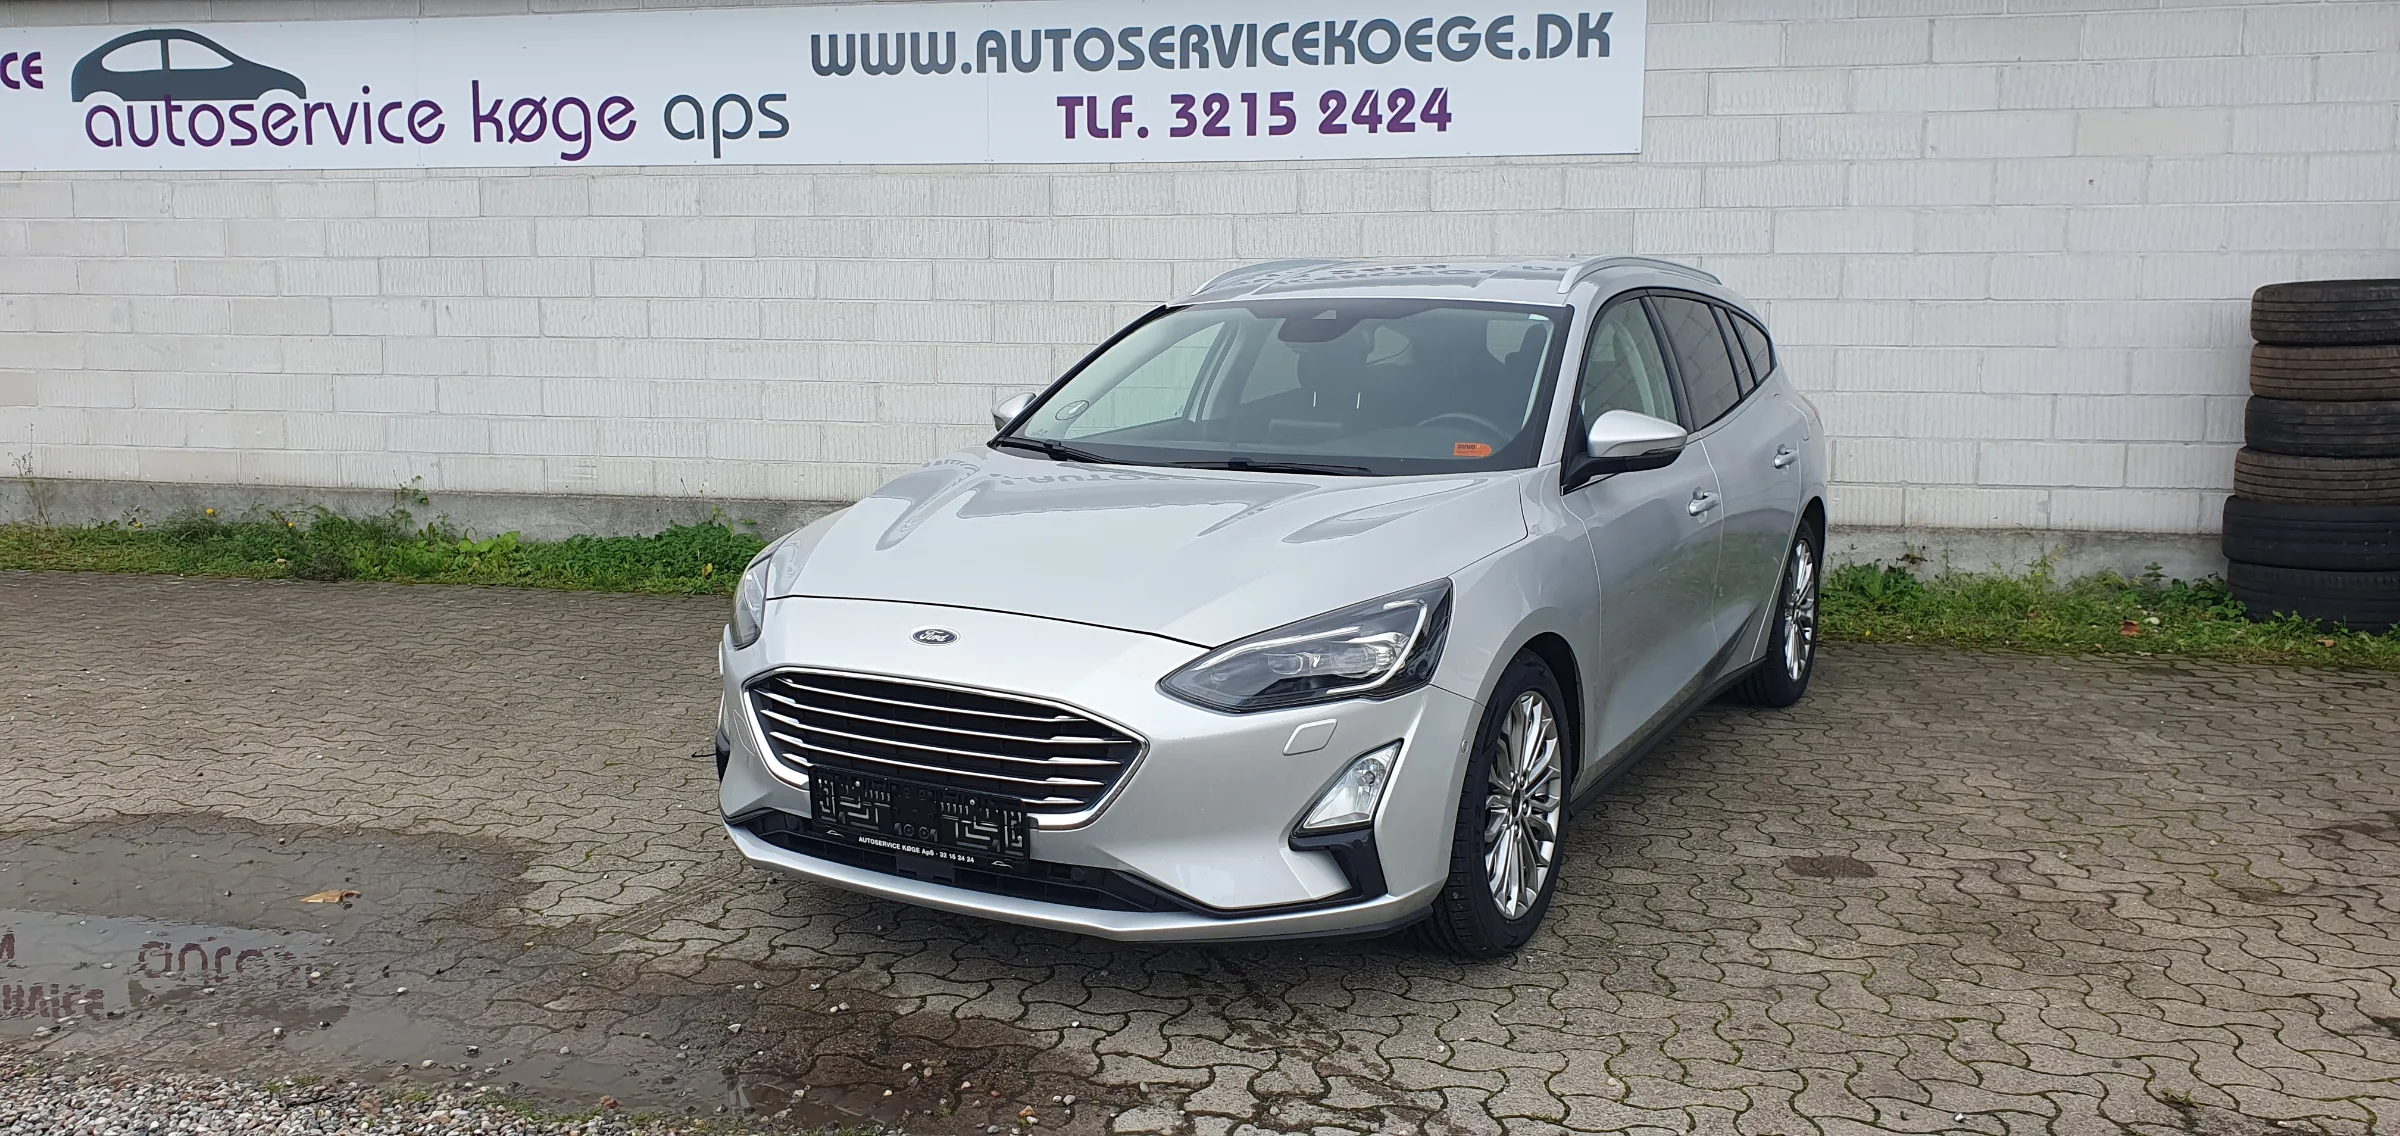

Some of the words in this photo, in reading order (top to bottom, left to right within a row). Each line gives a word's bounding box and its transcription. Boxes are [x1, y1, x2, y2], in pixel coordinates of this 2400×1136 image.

[810, 13, 1614, 77] WWW.AUTOSERVICEKOEGE.DK
[85, 85, 446, 148] autoservice
[471, 79, 637, 162] køge
[663, 93, 790, 159] aps
[1056, 94, 1149, 140] TLF.
[1169, 90, 1297, 139] 3215
[1318, 87, 1453, 136] 2424
[919, 630, 950, 642] Ford
[858, 836, 901, 850] AUTOSERVICE
[957, 854, 966, 862] 24
[966, 855, 975, 863] 24
